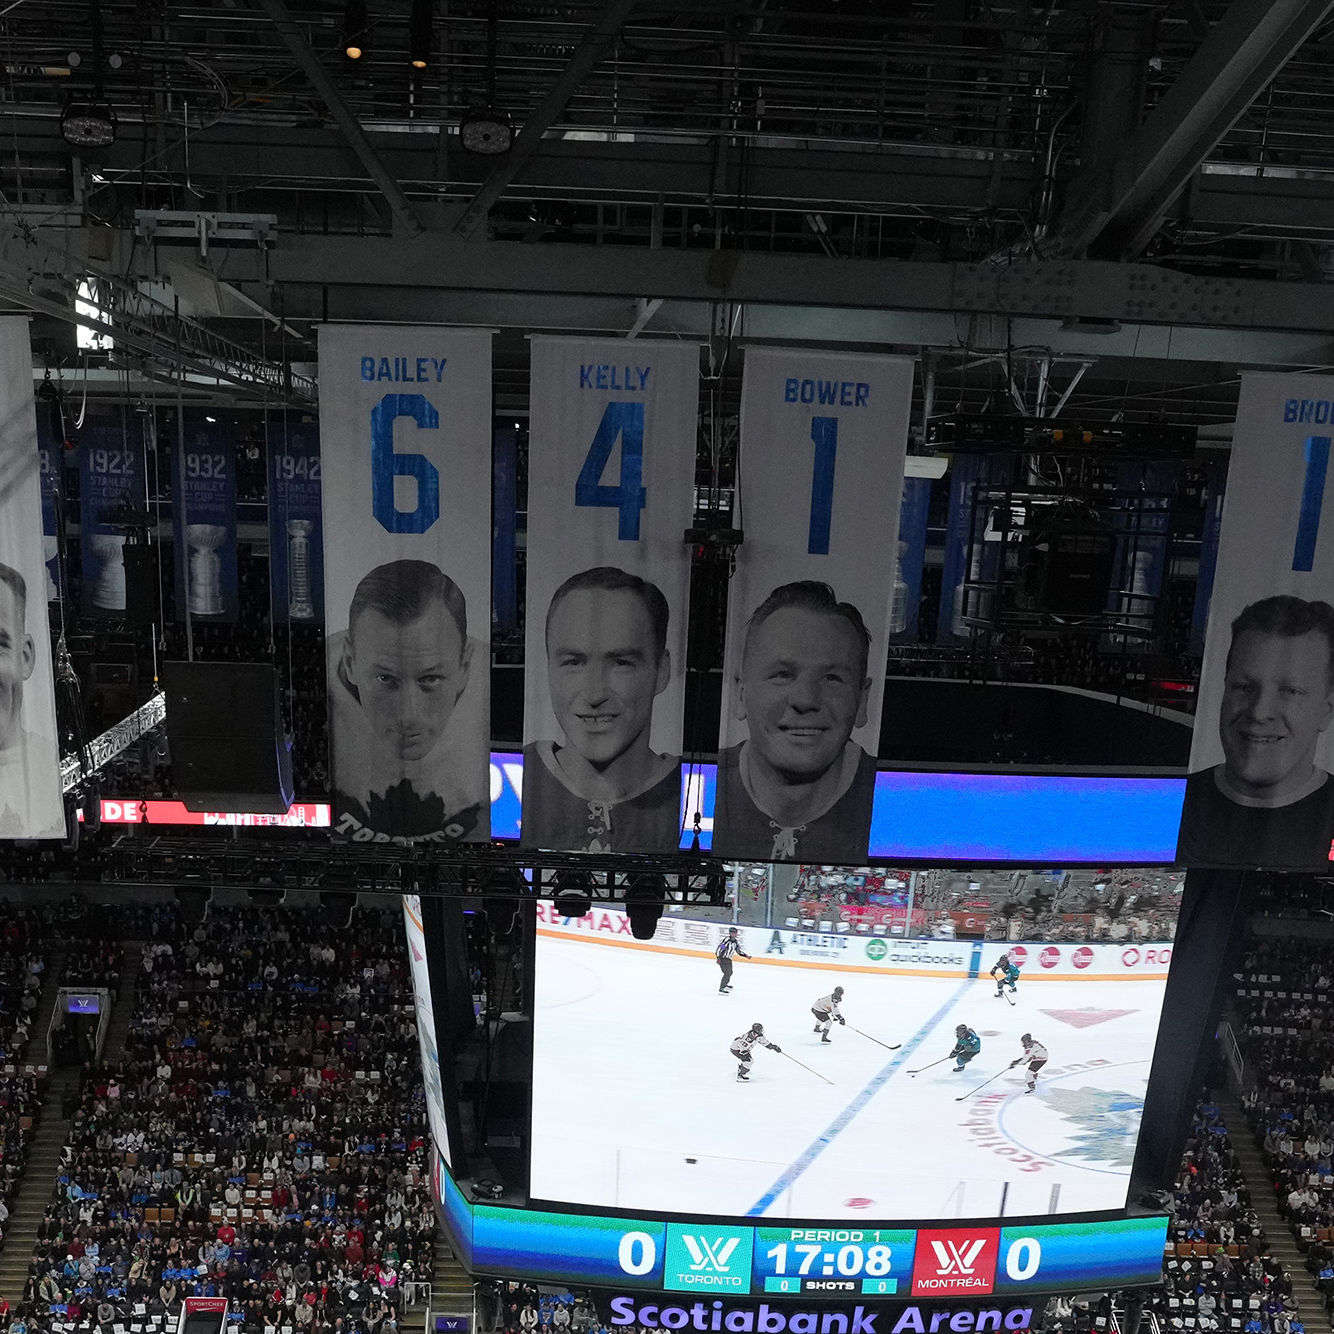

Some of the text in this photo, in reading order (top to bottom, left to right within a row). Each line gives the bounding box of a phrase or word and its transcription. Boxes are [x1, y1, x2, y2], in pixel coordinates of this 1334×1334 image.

[360, 356, 448, 384] BAILEY
[578, 364, 652, 391] KELLY
[784, 377, 871, 407] BOWER
[89, 449, 135, 475] 1922
[370, 393, 440, 534] 6
[574, 401, 648, 541] 4
[809, 416, 839, 556] 1
[1291, 435, 1332, 572] 1
[890, 951, 965, 966] quickbooks
[790, 1229, 881, 1243] PERIOD 1
[618, 1231, 656, 1276] 0
[767, 1243, 892, 1277] 17:08
[1005, 1238, 1042, 1281] 0
[677, 1273, 743, 1287] TORONTO
[780, 1280, 887, 1292] 0 SHOTS 0
[917, 1276, 990, 1289] MONTRÉAL
[608, 1296, 1034, 1334] Scotiabank Arena
